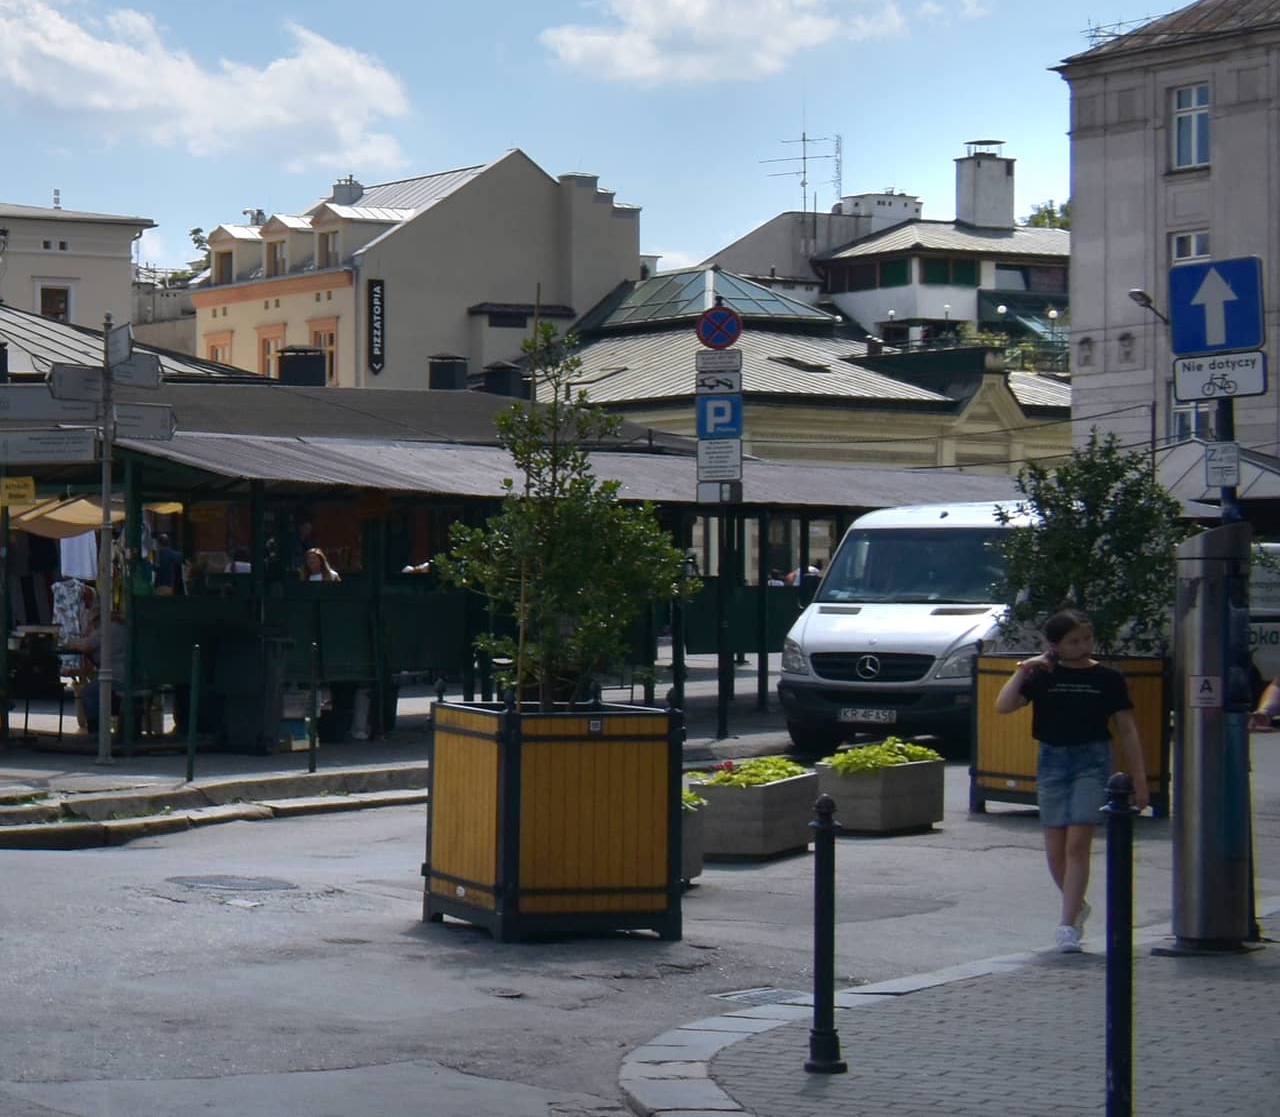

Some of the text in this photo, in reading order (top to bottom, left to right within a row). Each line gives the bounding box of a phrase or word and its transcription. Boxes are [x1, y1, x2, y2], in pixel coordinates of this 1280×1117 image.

[373, 285, 382, 355] PIZZATOPIA
[1182, 358, 1257, 373] Nie dotyczy
[706, 400, 732, 433] P
[1199, 679, 1213, 693] A
